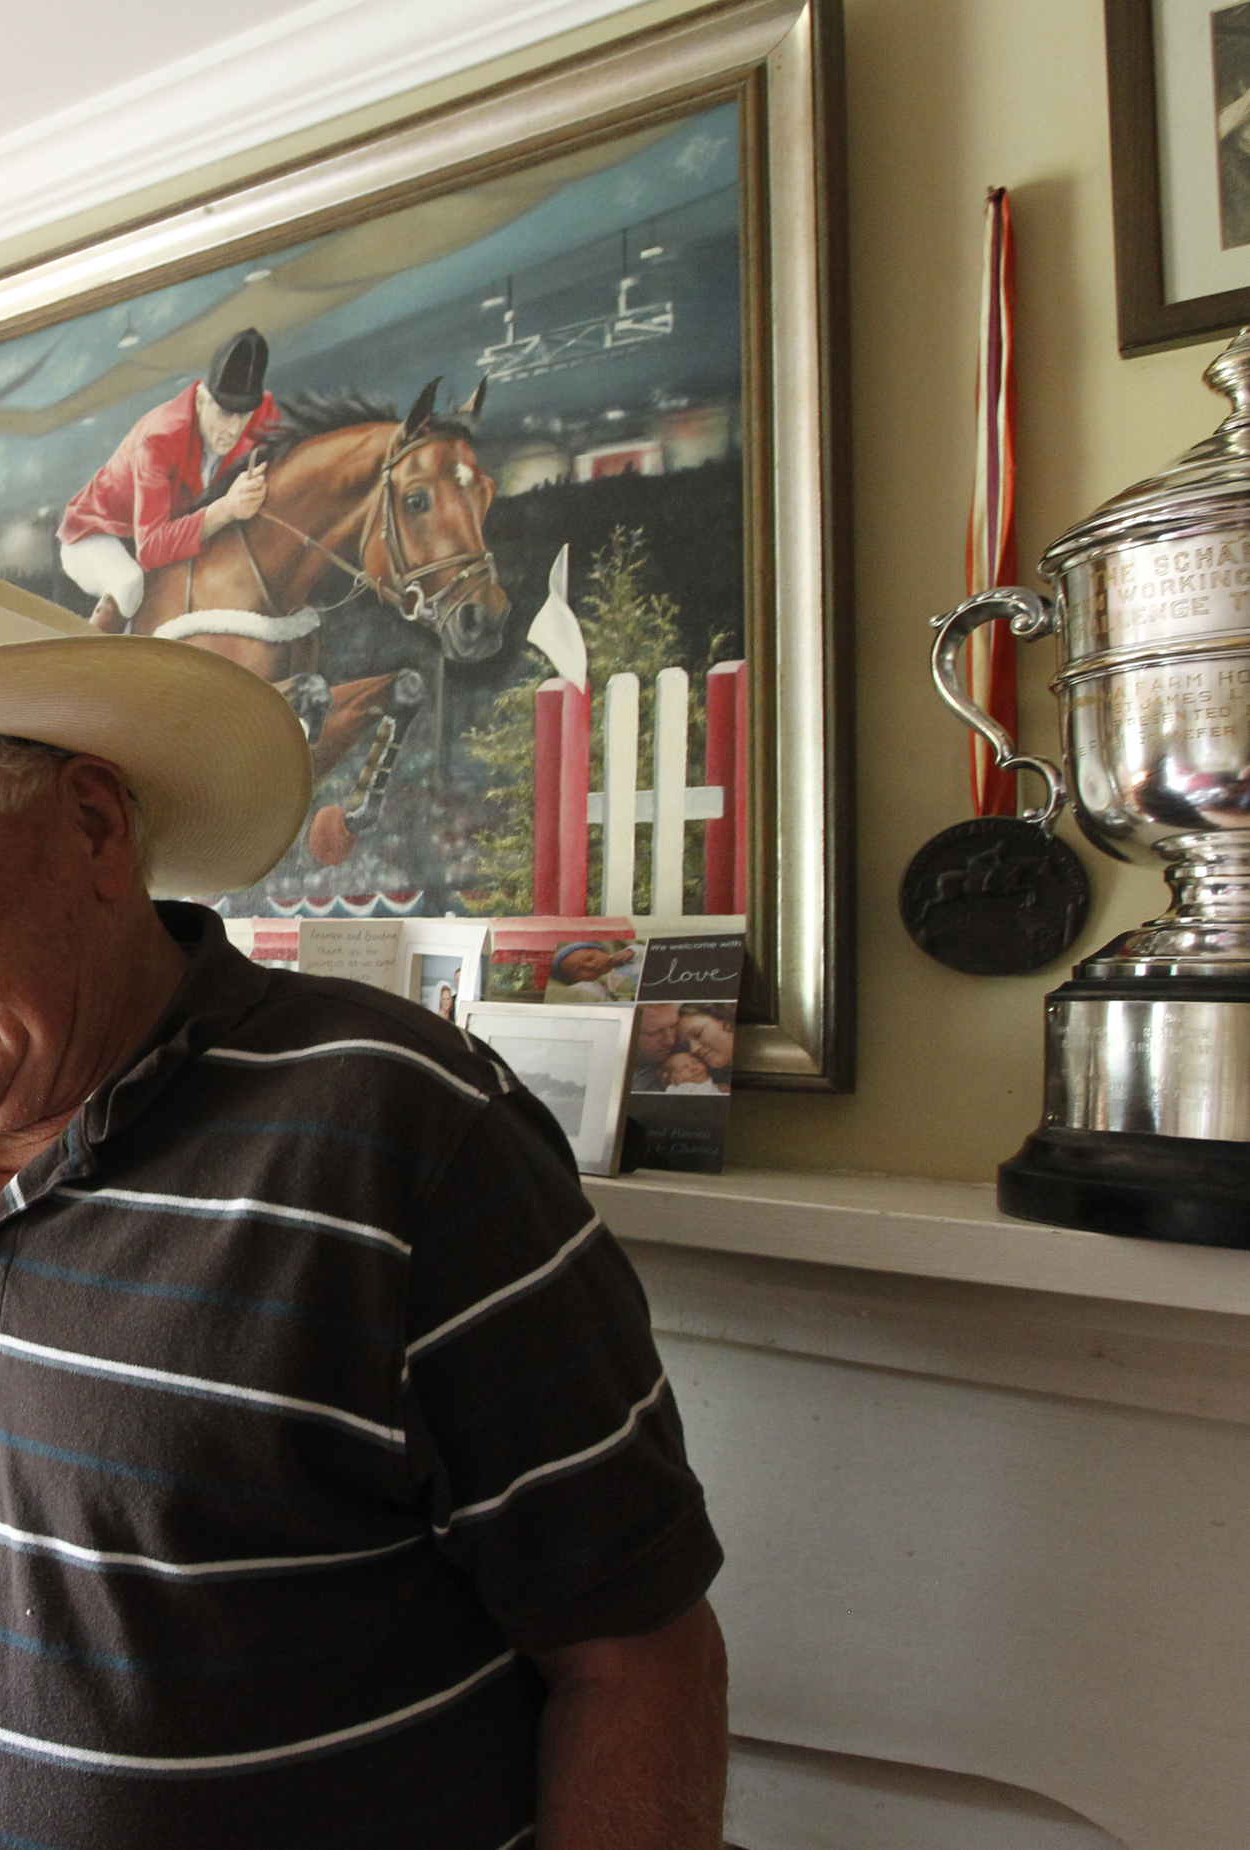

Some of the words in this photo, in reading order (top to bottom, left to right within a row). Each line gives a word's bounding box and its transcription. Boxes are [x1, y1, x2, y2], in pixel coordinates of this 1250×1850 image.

[1117, 567, 1250, 606] WORKING
[1135, 673, 1203, 696] FARM
[1139, 690, 1212, 712] JAMES
[651, 944, 667, 952] We
[669, 941, 717, 951] welcome
[719, 940, 743, 949] with
[642, 957, 738, 987] love
